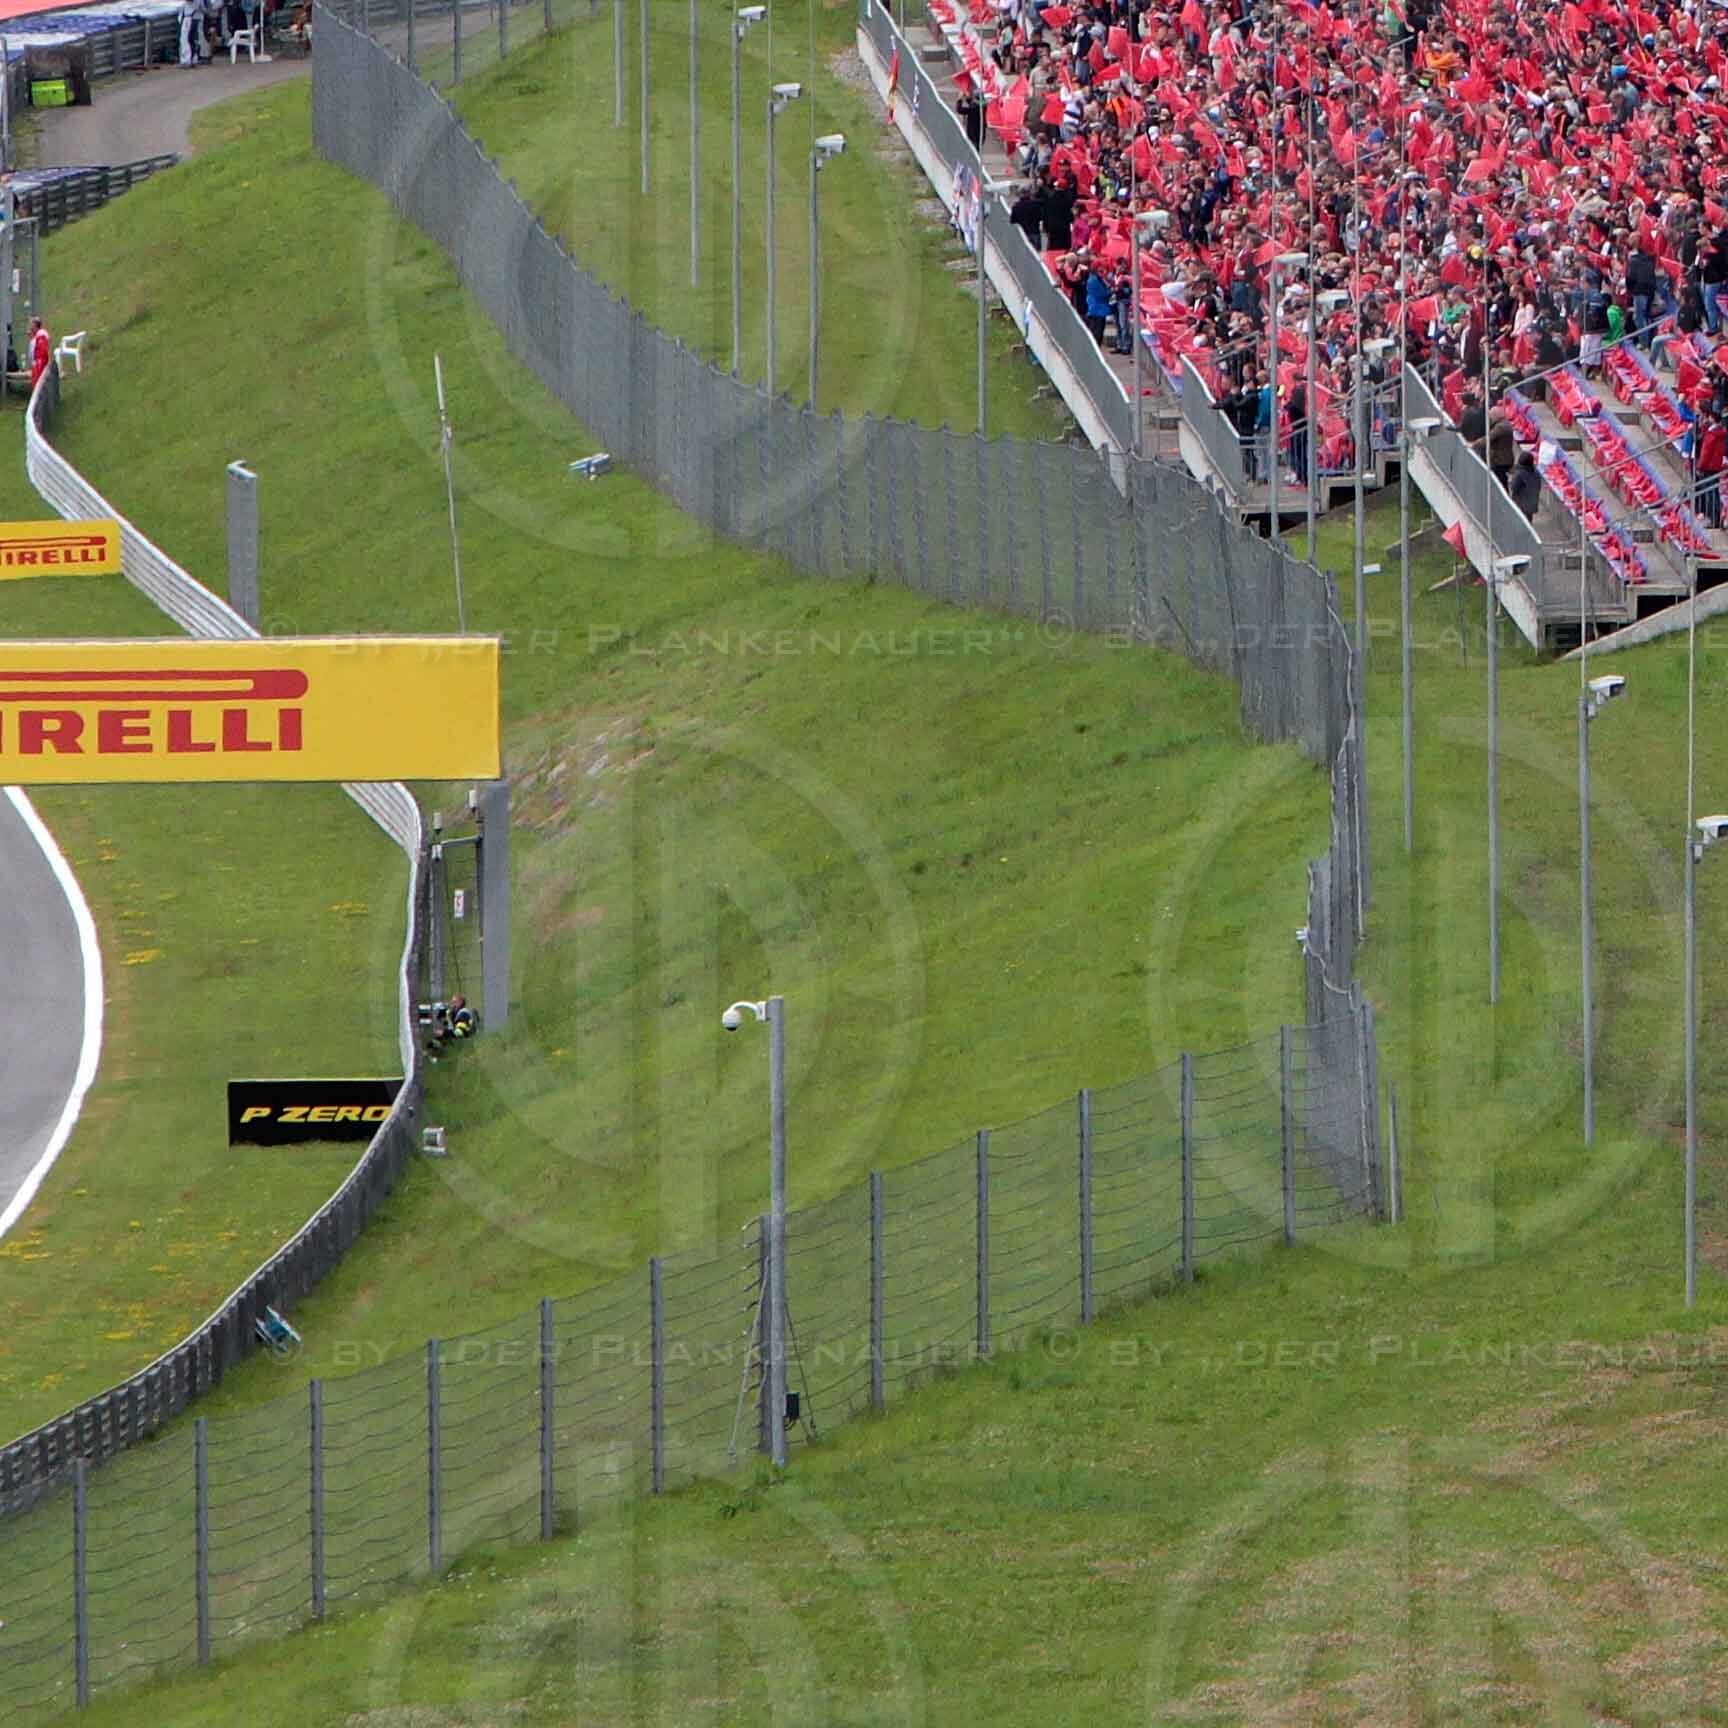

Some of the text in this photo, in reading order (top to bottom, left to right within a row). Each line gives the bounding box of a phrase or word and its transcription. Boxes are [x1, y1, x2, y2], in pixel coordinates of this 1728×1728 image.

[0, 548, 106, 565] IRELLI
[0, 707, 303, 754] RELLI
[240, 1106, 394, 1123] P ZERO
